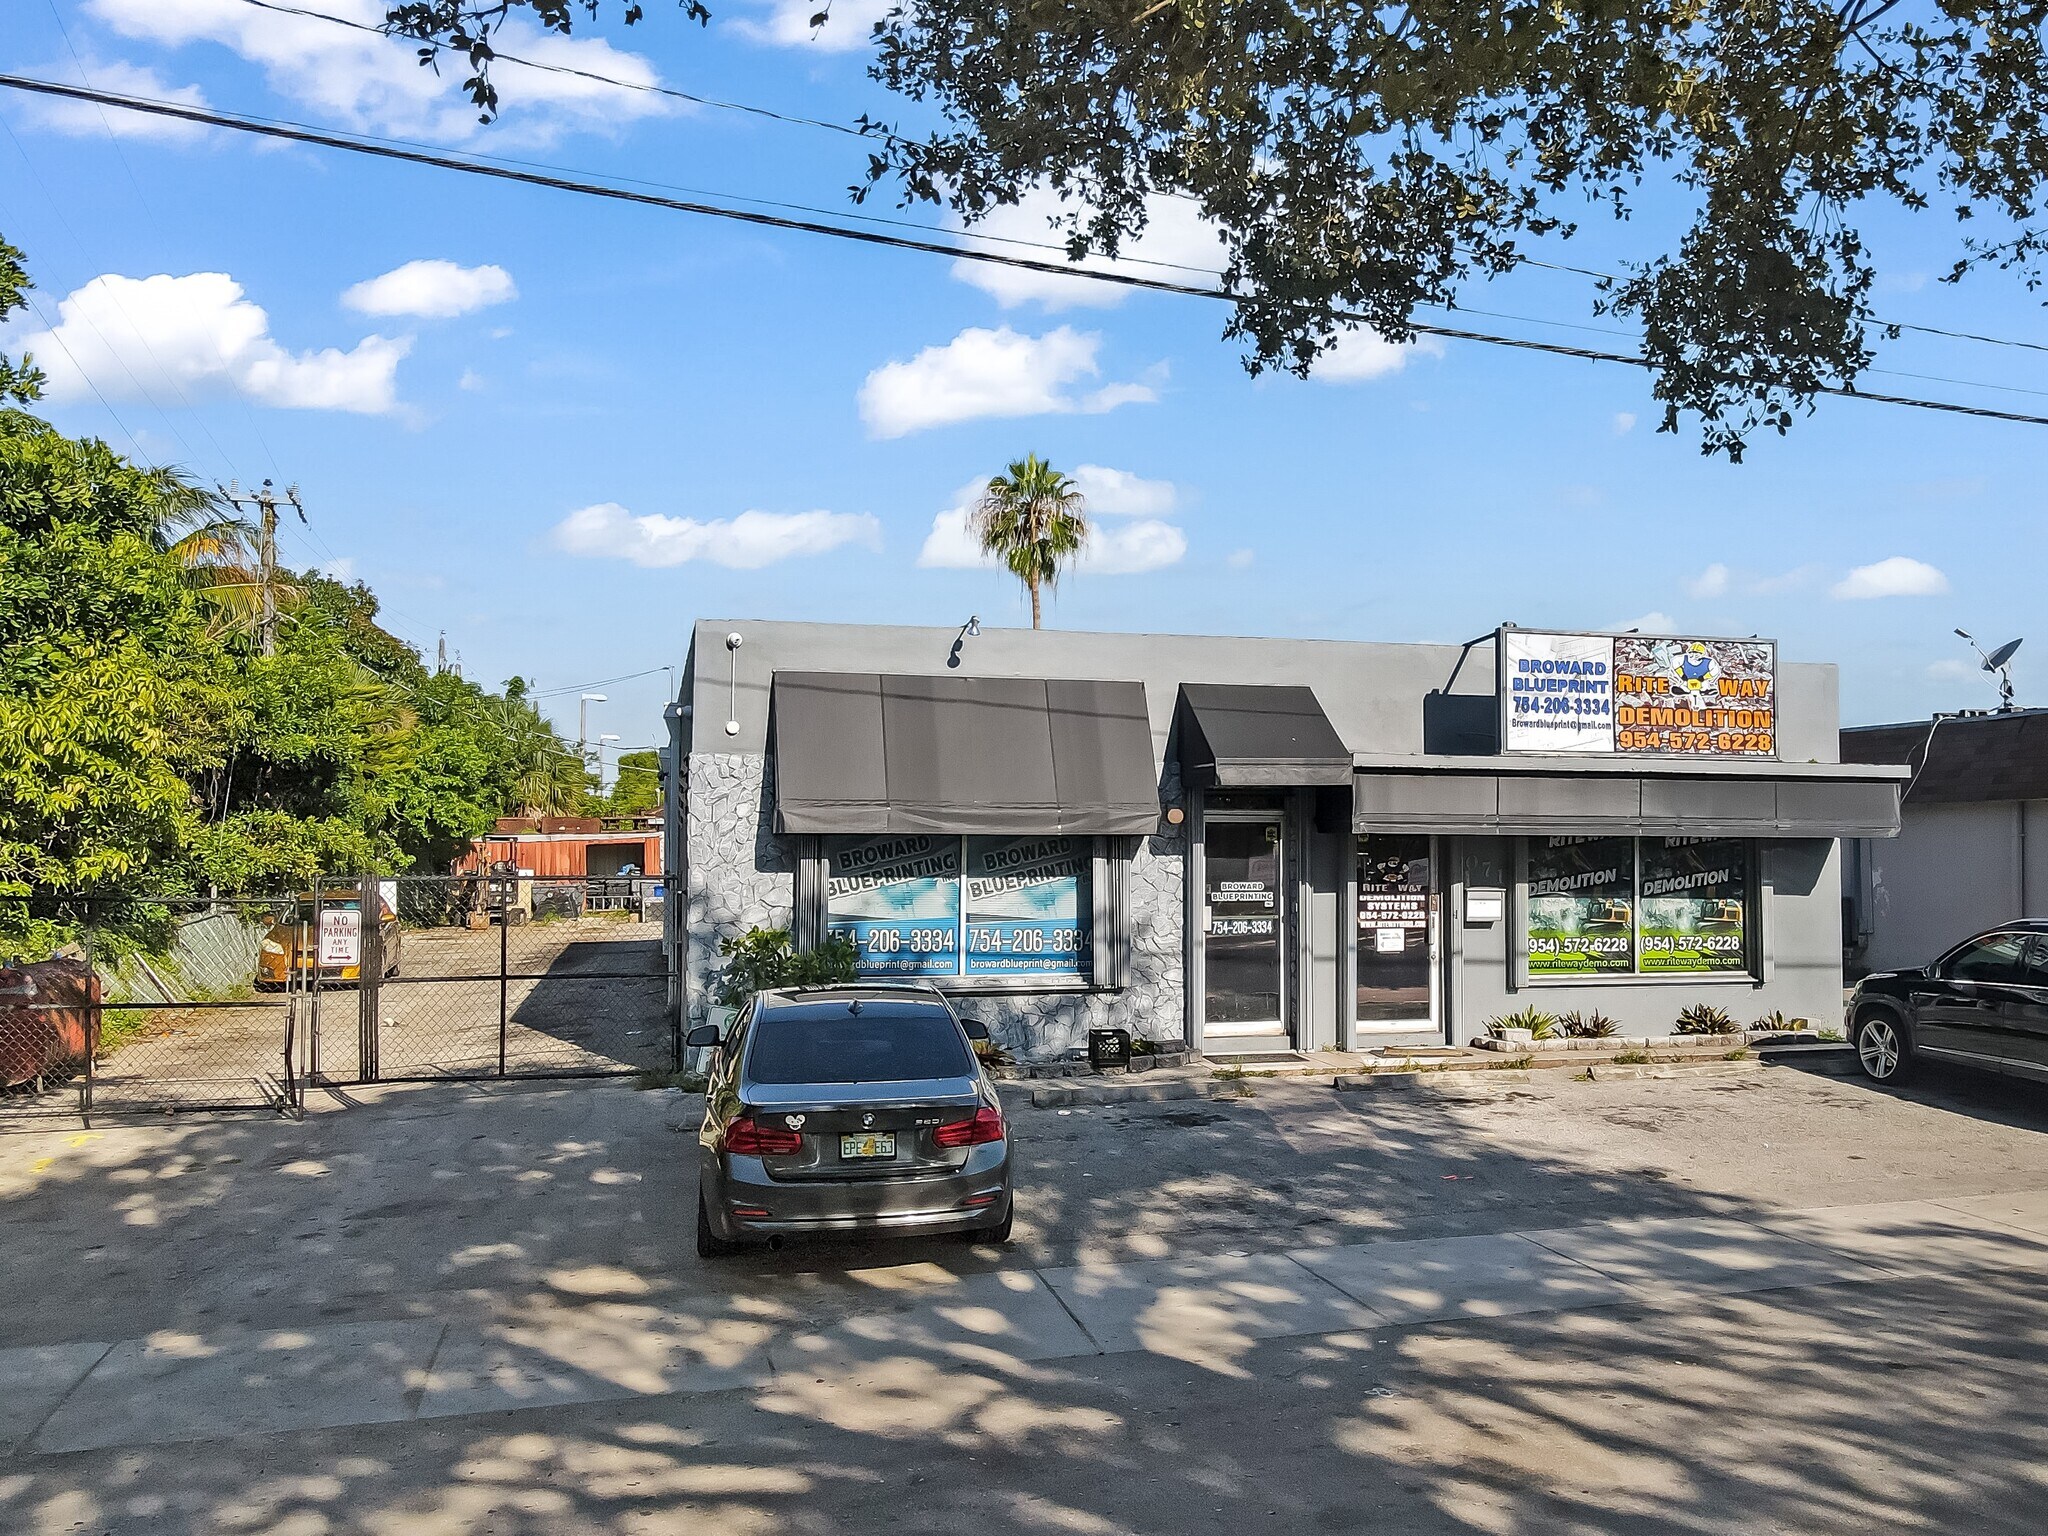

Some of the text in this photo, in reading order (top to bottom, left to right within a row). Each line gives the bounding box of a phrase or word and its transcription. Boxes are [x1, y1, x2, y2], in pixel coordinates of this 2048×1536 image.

[1518, 659, 1607, 676] BROWARD
[1512, 677, 1609, 694] BLUEPRINT
[1617, 674, 1770, 698] RITE WAY
[1513, 696, 1610, 715] 754-206-3334
[1618, 706, 1772, 729] DEMOLITION
[1618, 730, 1772, 752] 954-572-6228
[839, 836, 930, 869] BROWARD
[984, 838, 1072, 872] BROWARD
[828, 853, 957, 898] BLUEPRINTING
[1529, 868, 1617, 896] DEMOLITION
[1643, 868, 1730, 896] DEMOLITION
[1367, 902, 1418, 910] SYSTEMS
[333, 916, 348, 926] NO
[1212, 921, 1272, 934] 754-206-3334
[323, 928, 357, 937] PARKING
[969, 928, 1093, 953] 754-206-3334
[1564, 937, 1629, 953] 572-6228
[1640, 936, 1740, 955] (954) 572-6228
[970, 958, 1092, 970] browardblueprint@gmail.com
[1529, 959, 1629, 969] www.ritewaydemo.com
[1643, 956, 1741, 968] www.ritewaydemo.com
